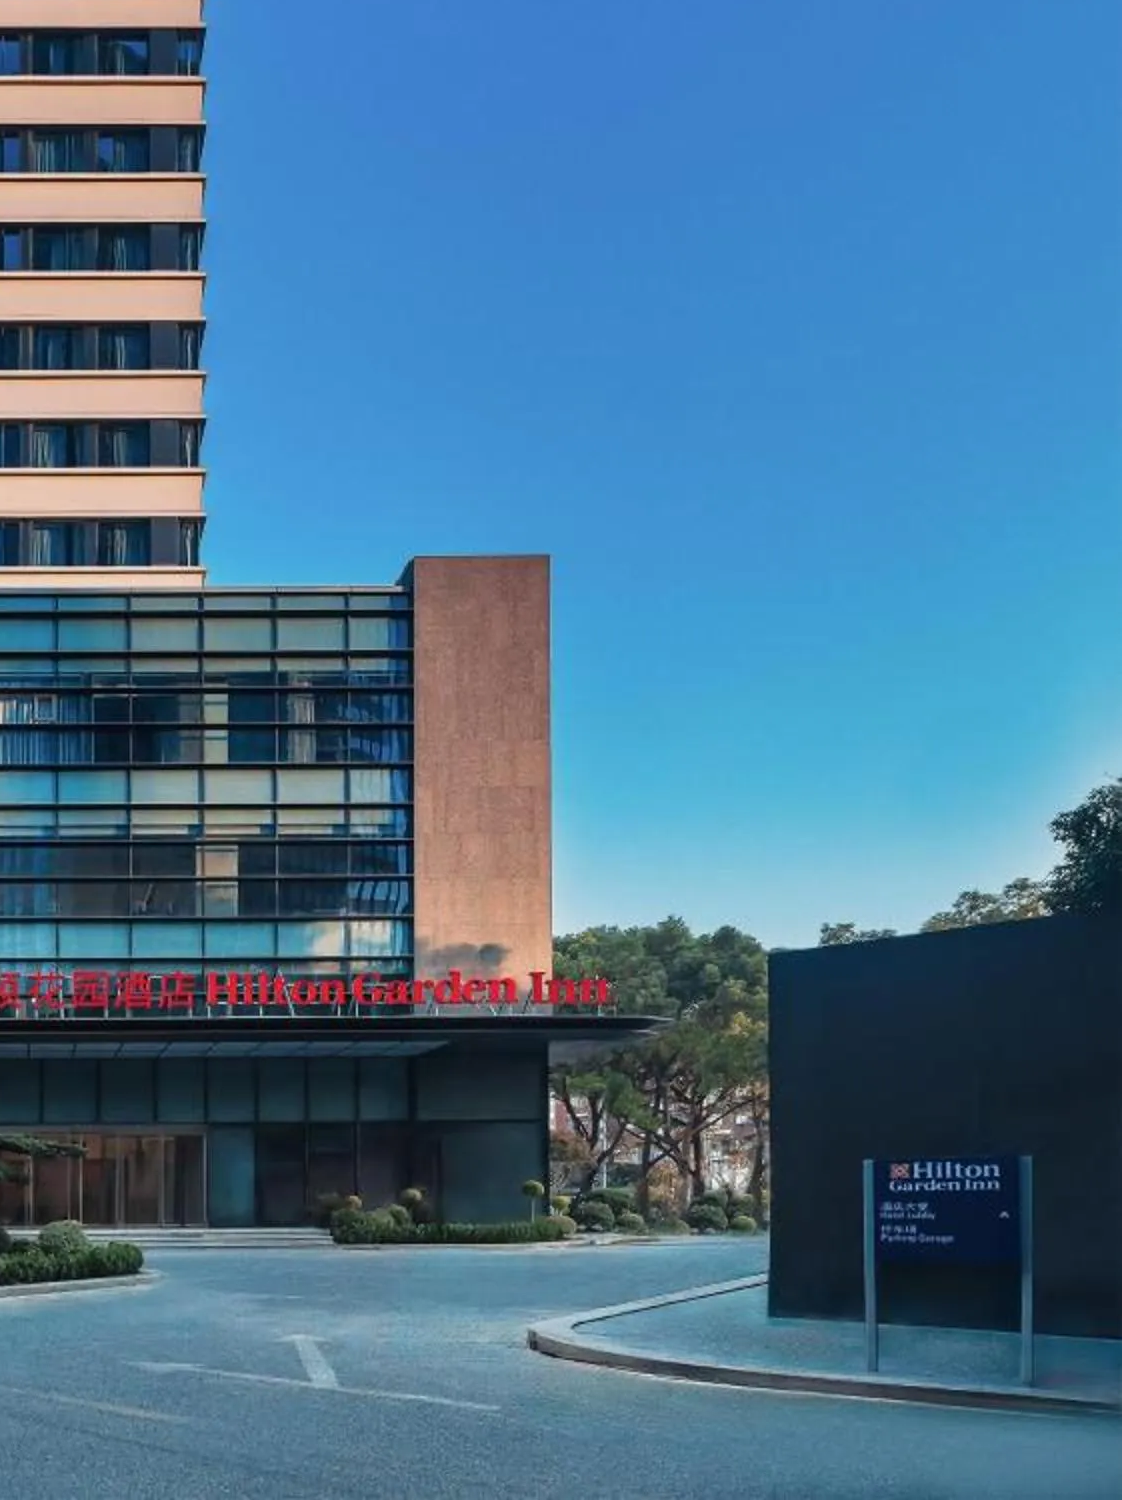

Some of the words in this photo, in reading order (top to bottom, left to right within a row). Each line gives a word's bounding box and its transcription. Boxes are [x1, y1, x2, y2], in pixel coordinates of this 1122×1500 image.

[206, 970, 346, 1005] Hilton
[352, 969, 518, 1004] Garden
[528, 971, 608, 1005] Inn
[912, 1161, 1001, 1179] Hilton
[889, 1179, 960, 1191] Garden
[964, 1179, 1000, 1191] Inn
